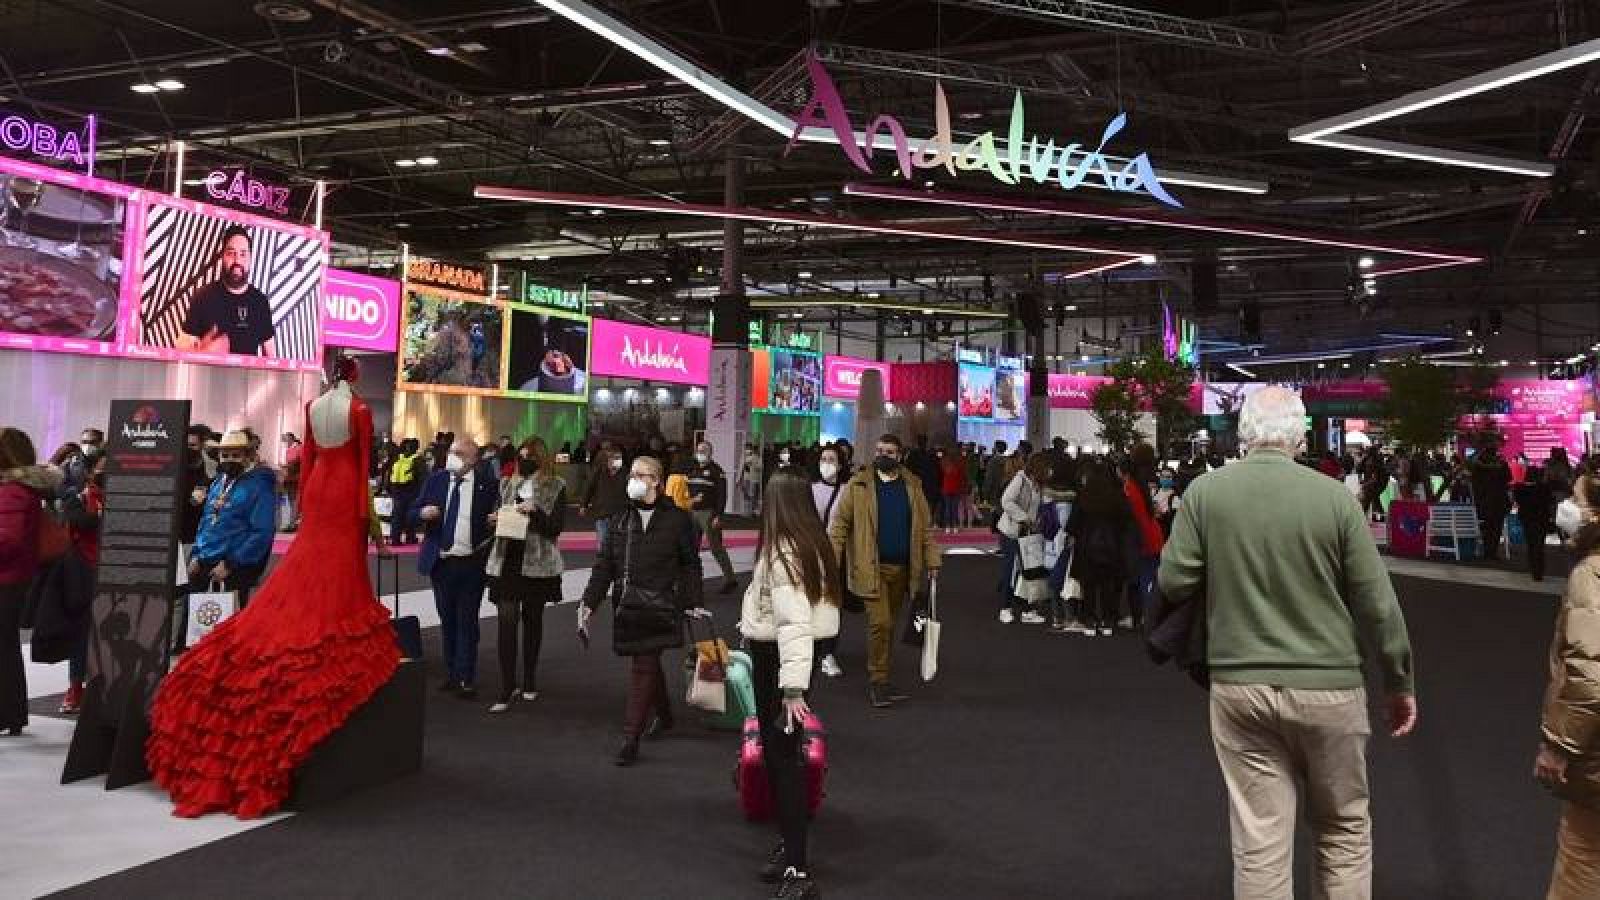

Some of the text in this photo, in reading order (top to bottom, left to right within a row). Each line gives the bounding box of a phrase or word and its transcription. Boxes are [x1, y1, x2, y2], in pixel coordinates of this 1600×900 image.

[0, 115, 83, 165] OBA
[783, 54, 1184, 208] Andalucía
[206, 169, 290, 214] CÁDIZ
